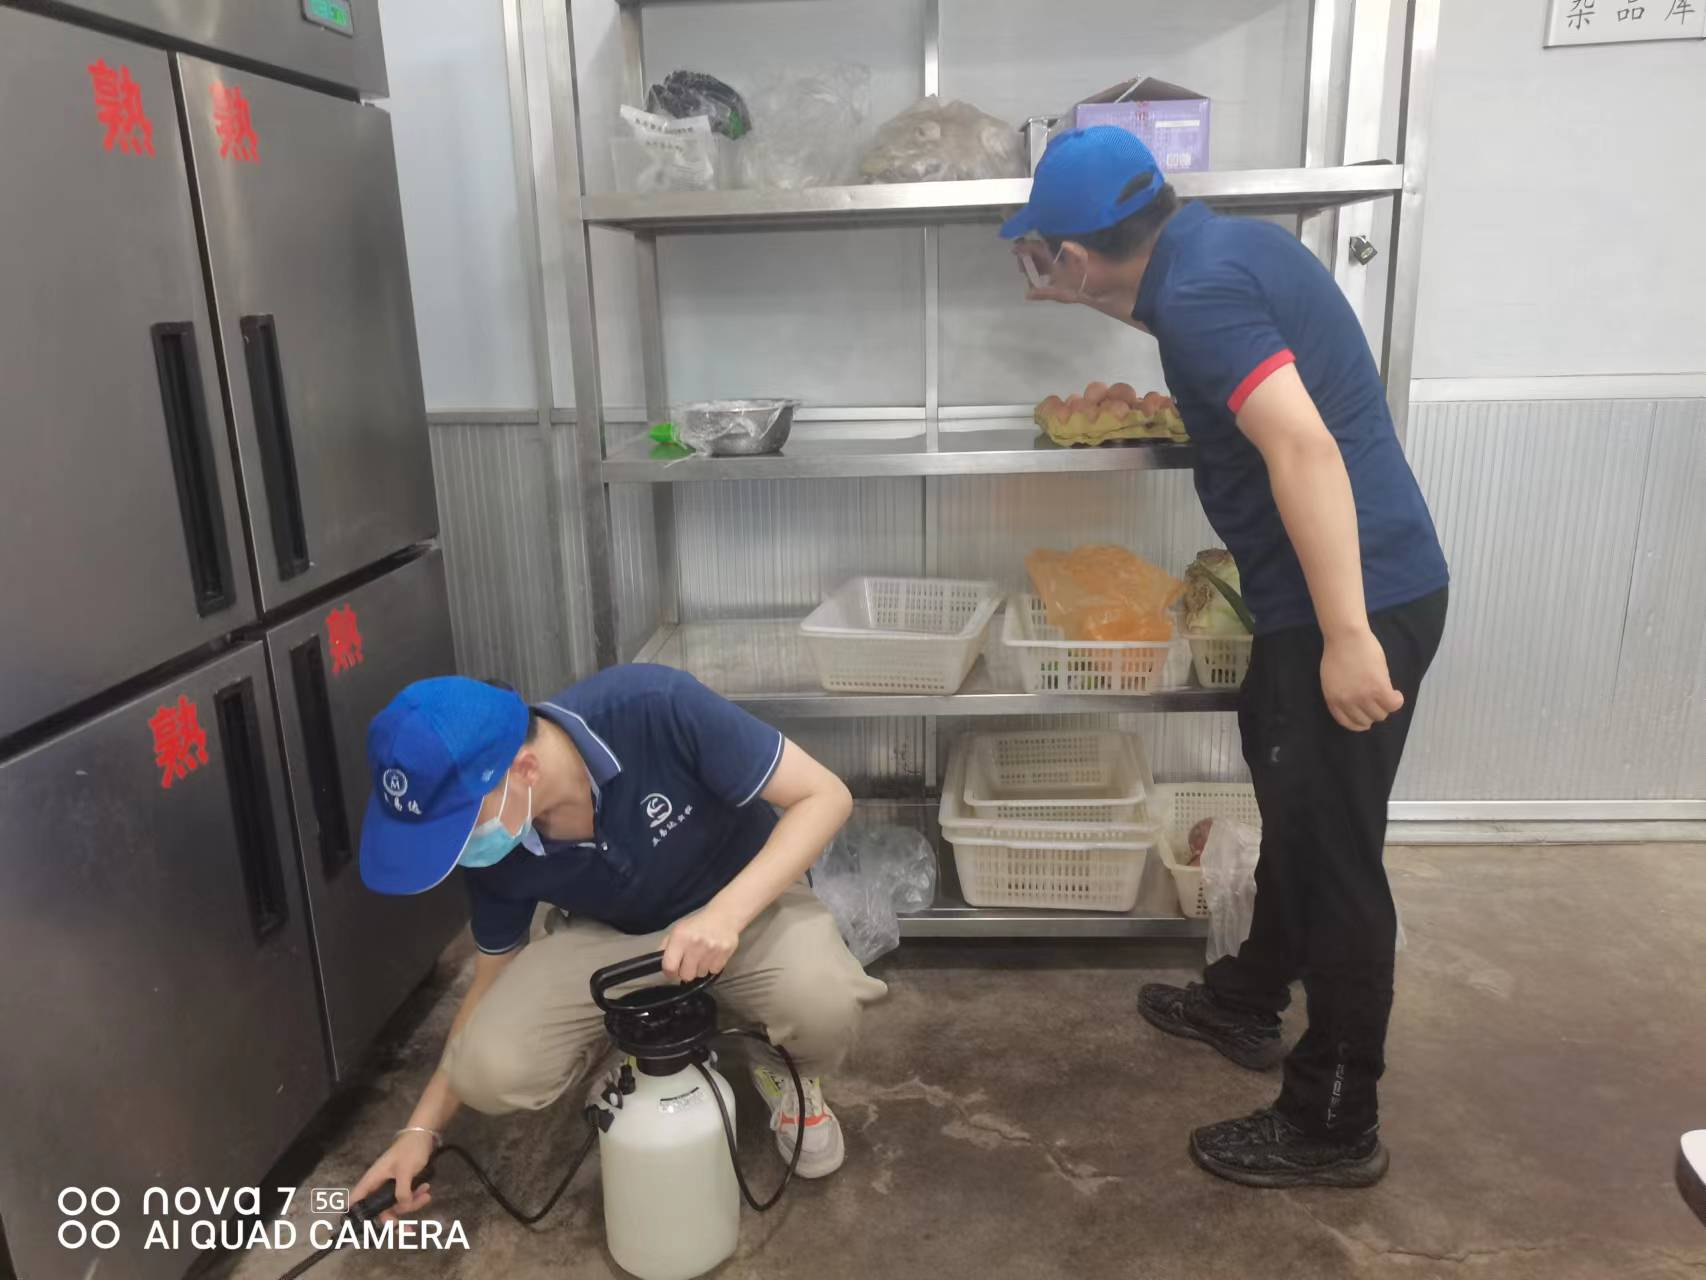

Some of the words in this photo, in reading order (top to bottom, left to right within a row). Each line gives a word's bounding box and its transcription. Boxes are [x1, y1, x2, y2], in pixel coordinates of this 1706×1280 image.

[86, 57, 156, 158] 熟
[208, 79, 261, 164] 熟
[326, 603, 363, 673] 熟
[147, 694, 209, 789] 熟
